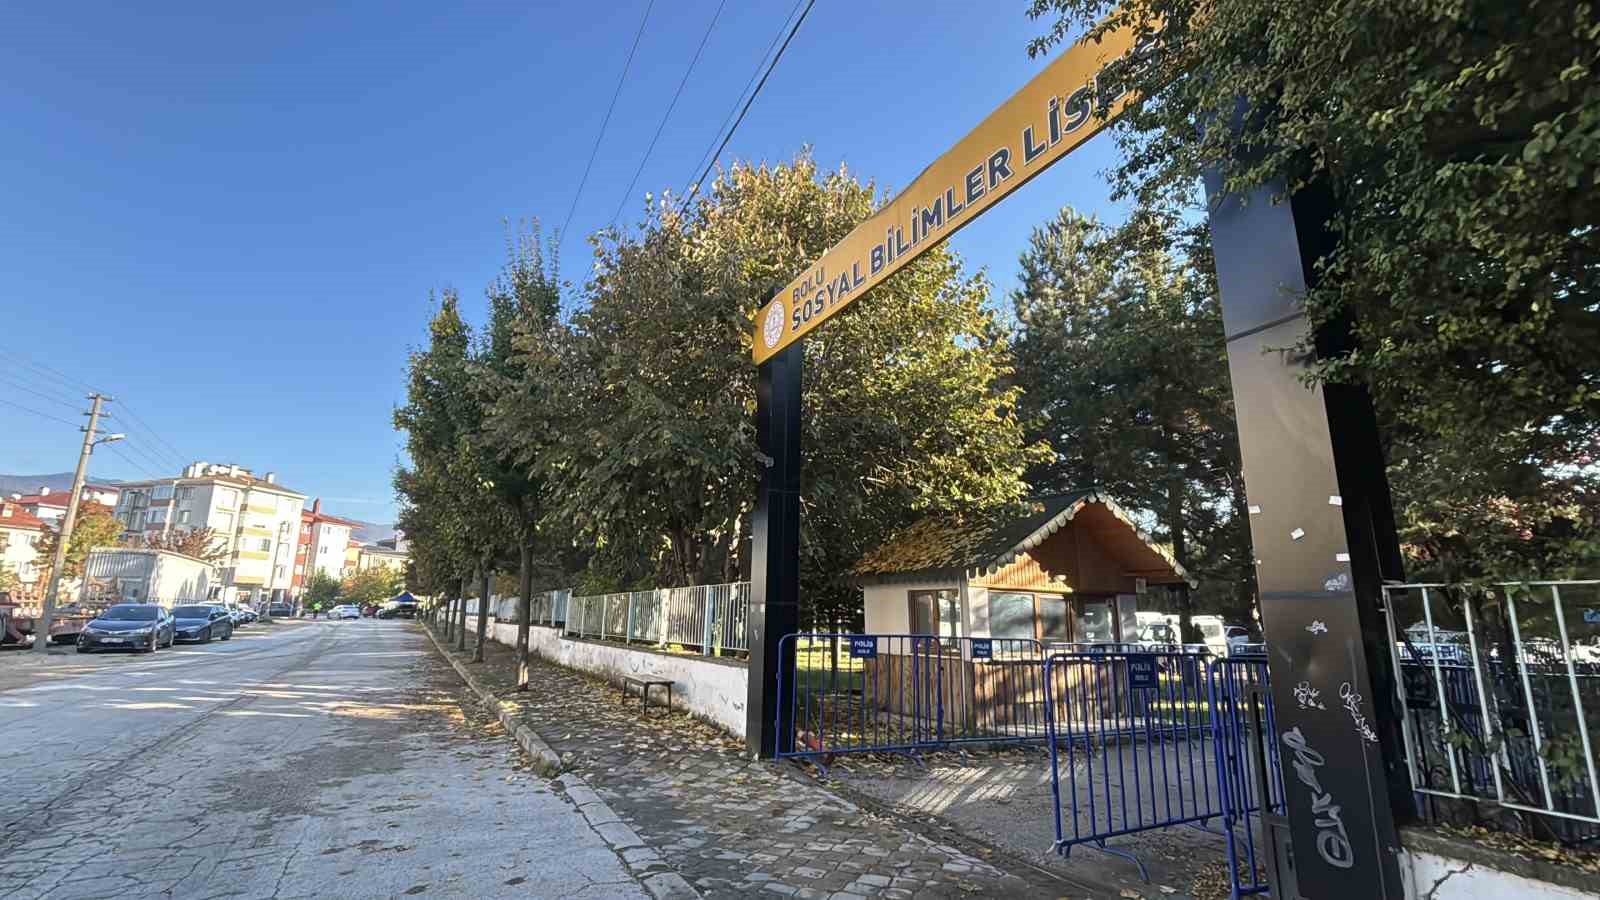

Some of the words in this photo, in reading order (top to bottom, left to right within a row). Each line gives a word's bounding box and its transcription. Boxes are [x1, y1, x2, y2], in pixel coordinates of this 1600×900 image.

[791, 262, 866, 332] SOSYAL
[869, 147, 1015, 278] BİLİMLER
[792, 266, 824, 304] BOLU
